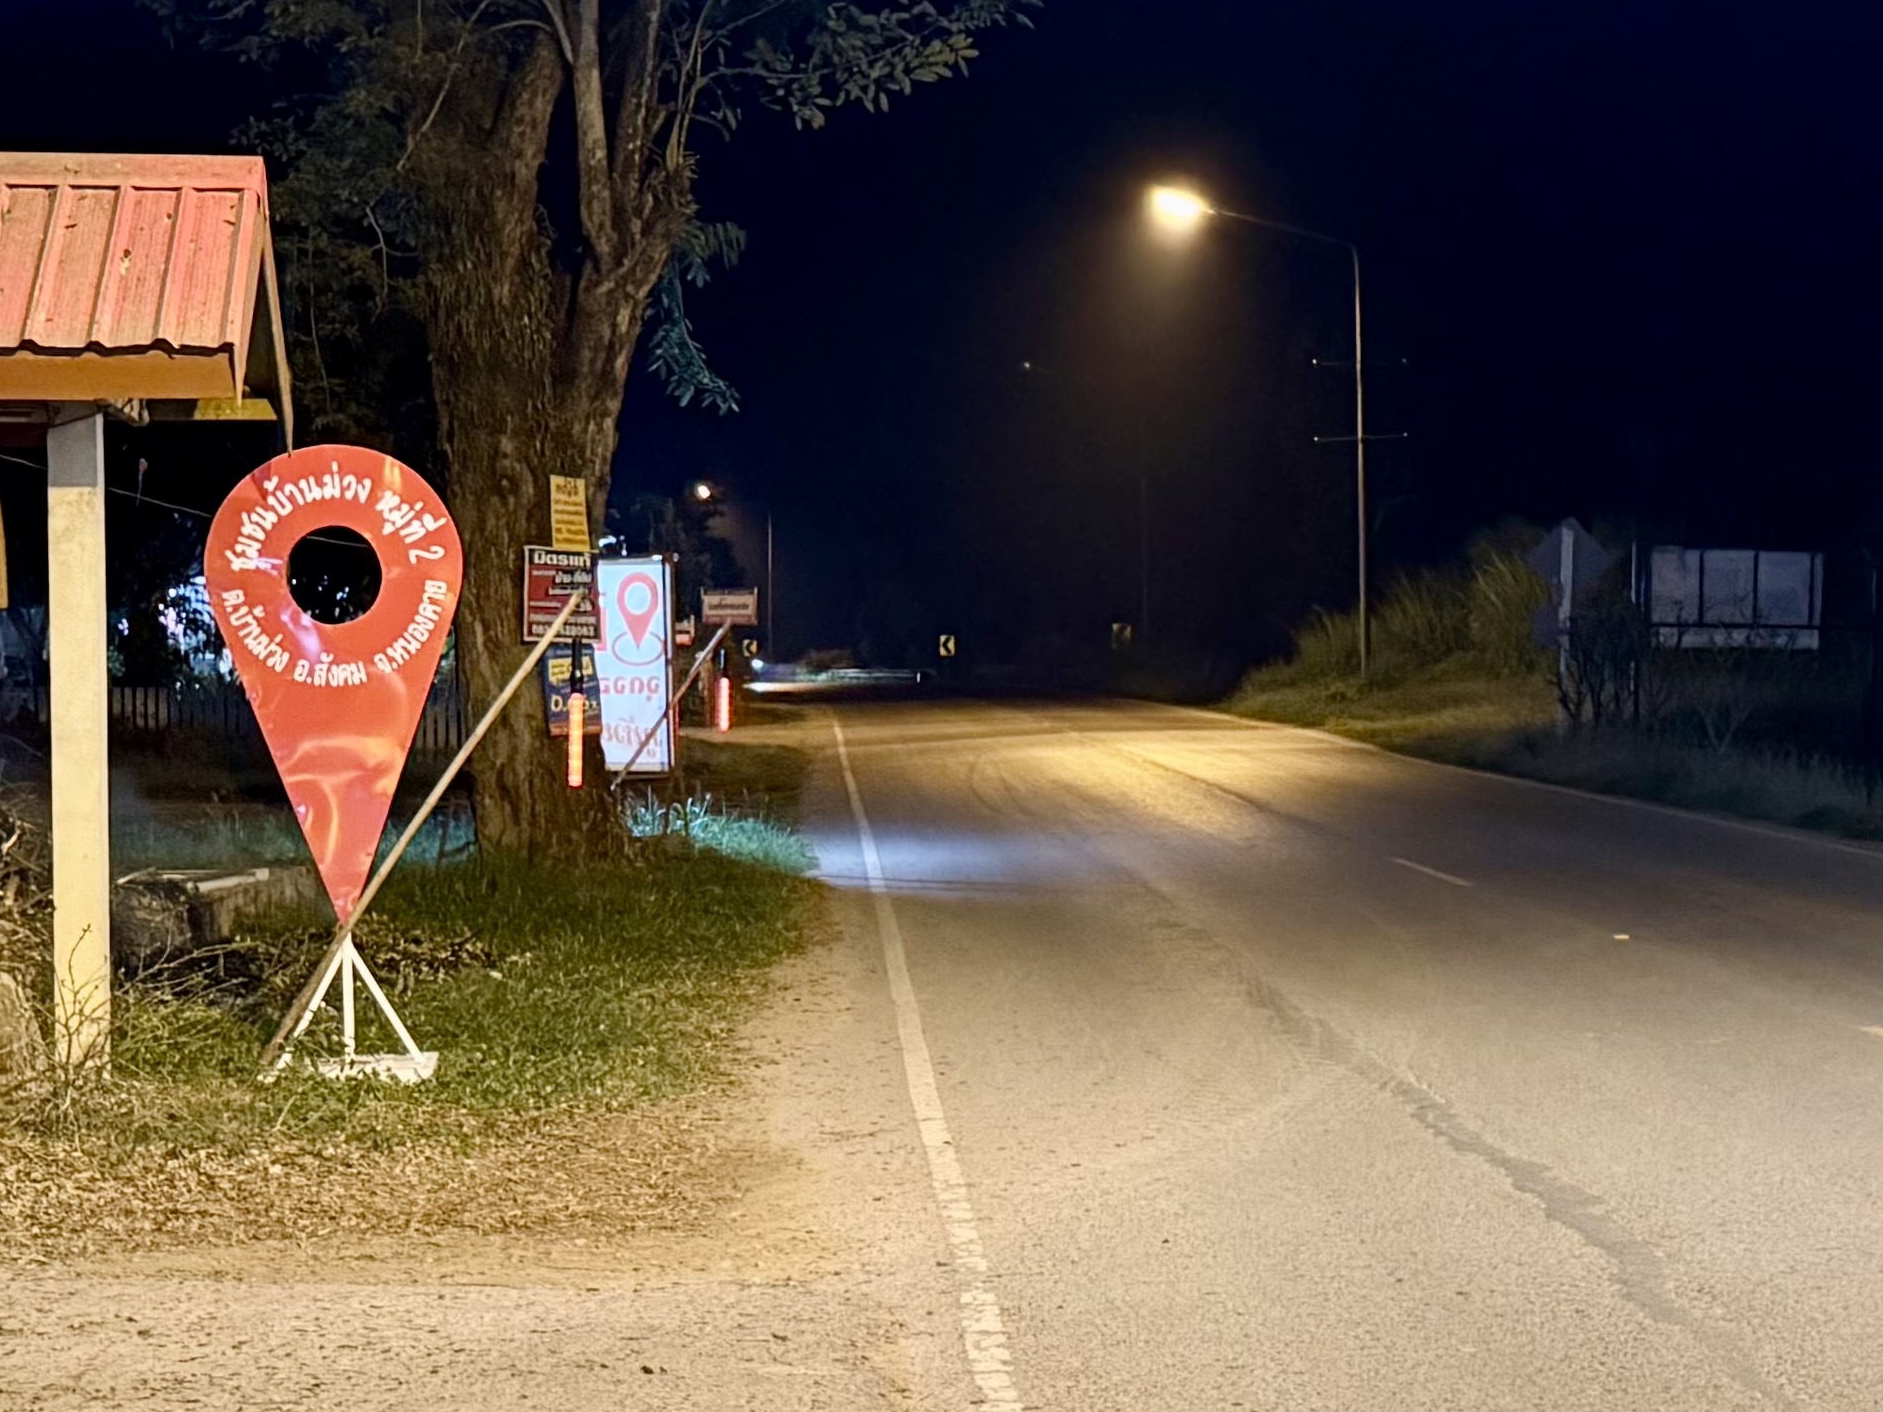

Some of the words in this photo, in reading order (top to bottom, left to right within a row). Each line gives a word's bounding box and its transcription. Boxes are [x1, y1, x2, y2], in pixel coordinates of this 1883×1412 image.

[408, 544, 446, 566] 2
[221, 588, 291, 673] ต.บ้านม่วง
[293, 651, 368, 687] อ.สังคม
[373, 579, 448, 674] จ.หนองคาย
